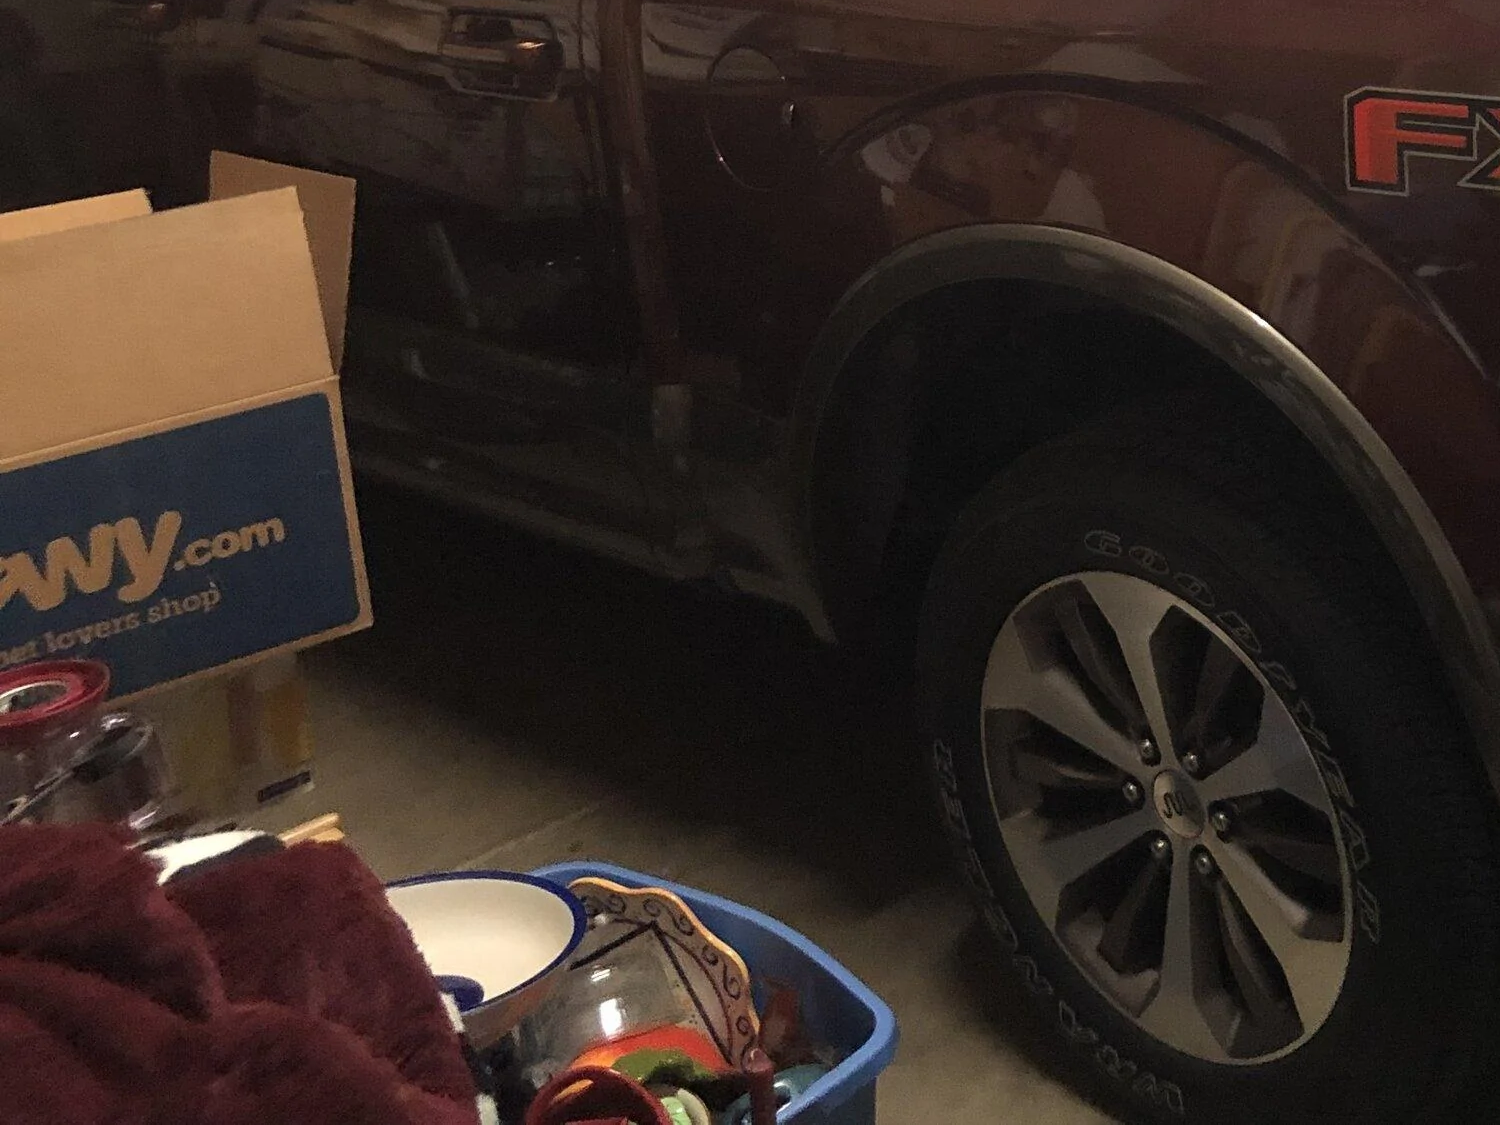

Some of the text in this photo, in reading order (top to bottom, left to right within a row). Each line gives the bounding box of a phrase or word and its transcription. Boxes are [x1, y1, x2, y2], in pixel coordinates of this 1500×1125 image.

[44, 611, 140, 652] lovers
[148, 585, 221, 624] shop
[1083, 528, 1380, 944] GOODYEAR
